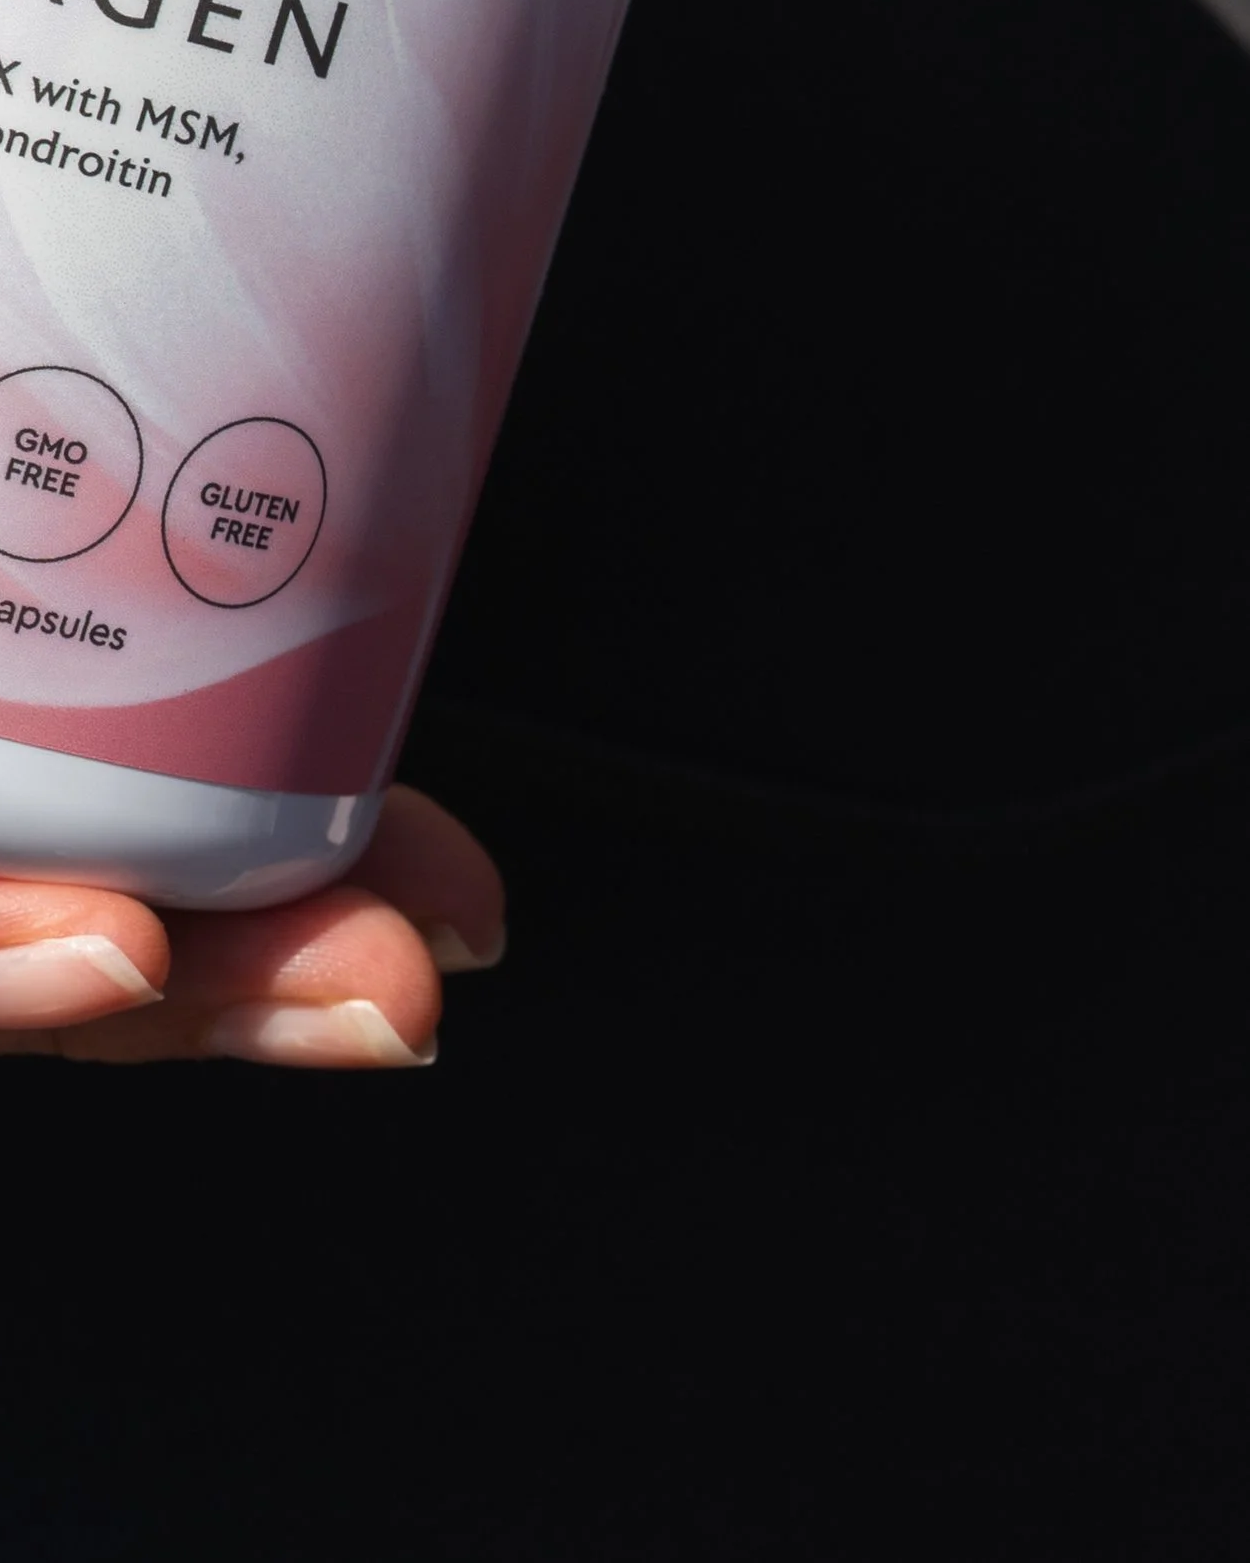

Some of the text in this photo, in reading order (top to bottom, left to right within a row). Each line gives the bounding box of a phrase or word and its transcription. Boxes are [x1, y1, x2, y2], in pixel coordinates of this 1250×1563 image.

[33, 77, 121, 125] with
[136, 98, 244, 164] MSM,
[15, 428, 87, 465] GMO
[5, 458, 80, 497] FREE
[200, 482, 300, 523] GLUTEN
[211, 517, 273, 550] FREE
